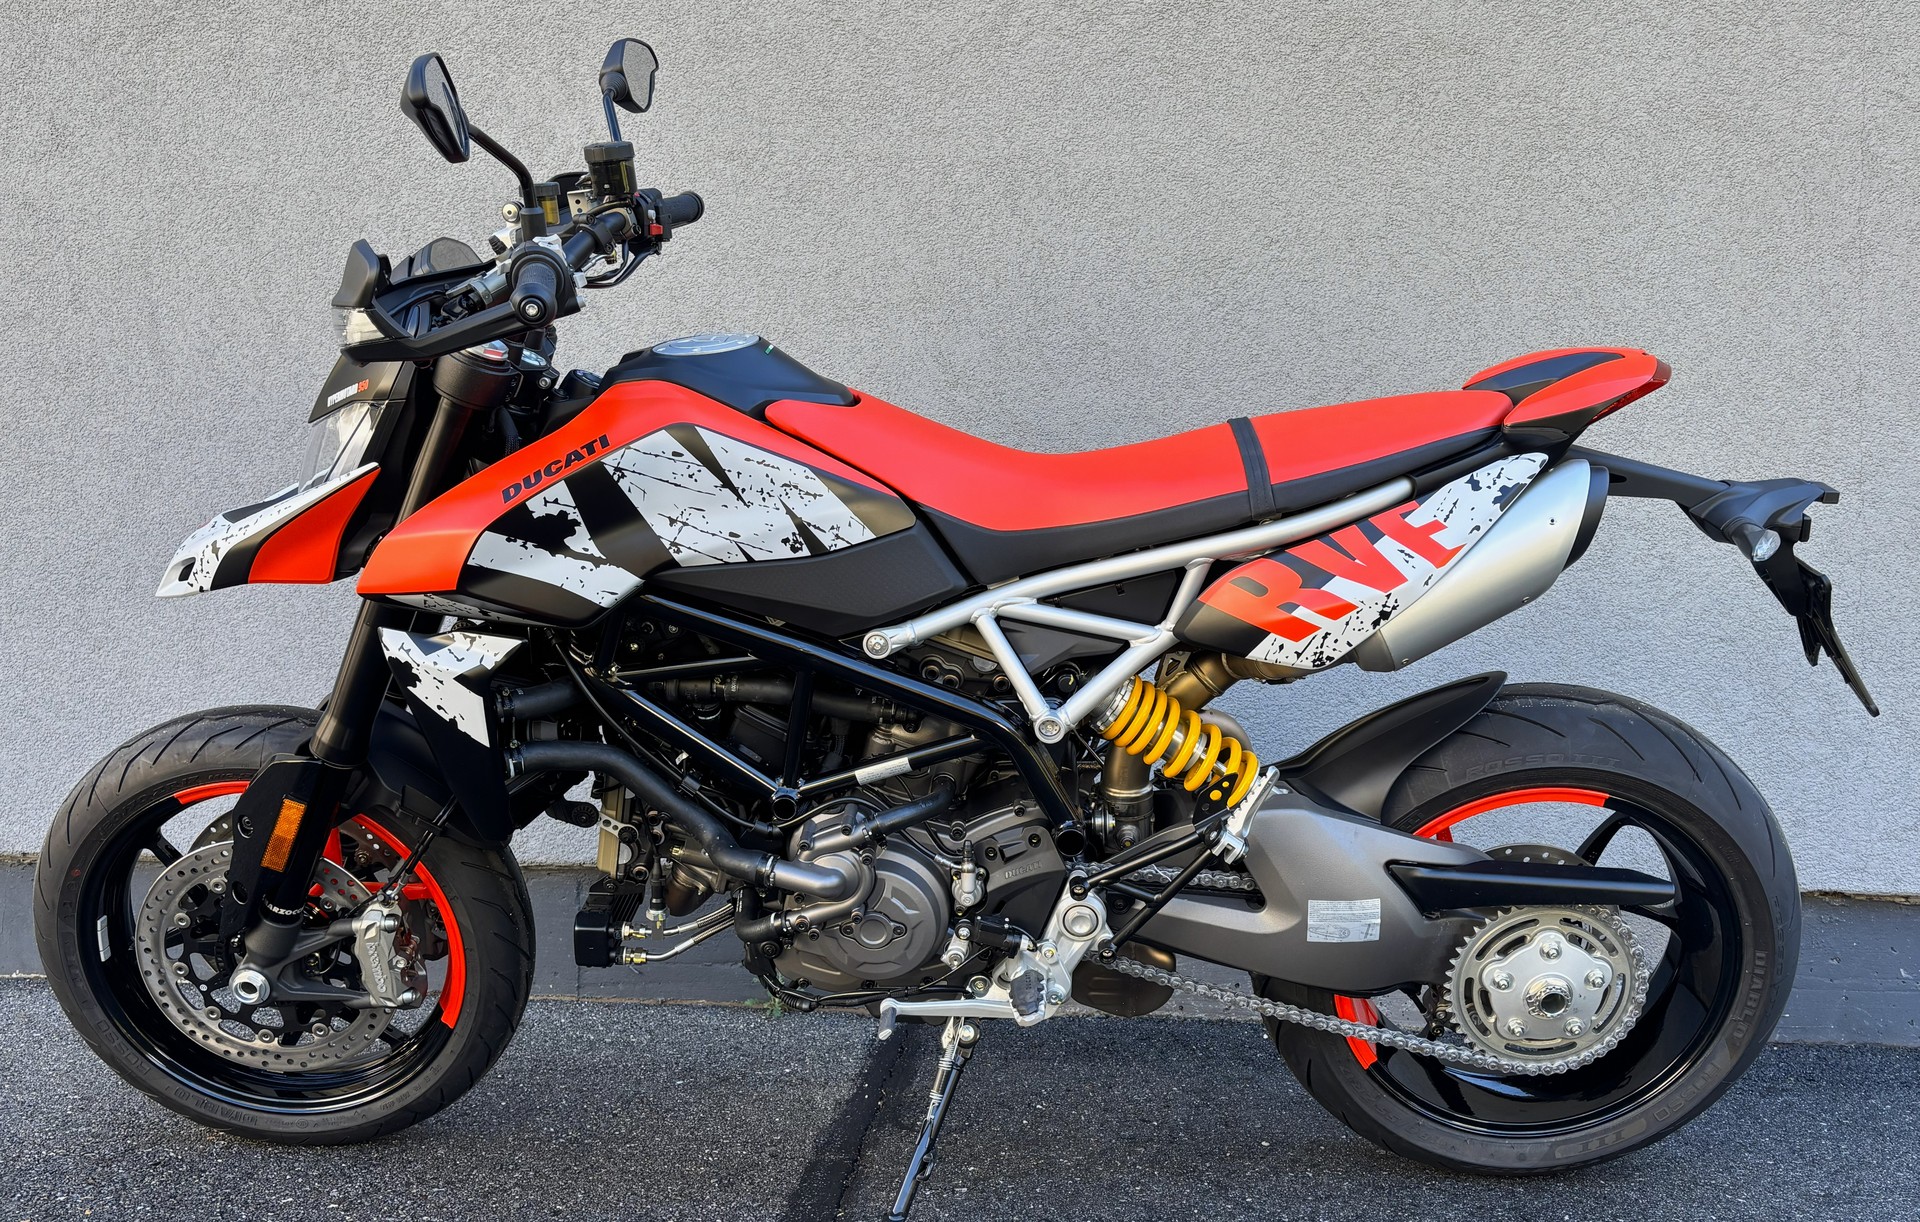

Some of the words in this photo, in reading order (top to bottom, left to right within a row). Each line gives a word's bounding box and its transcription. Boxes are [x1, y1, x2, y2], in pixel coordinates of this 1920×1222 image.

[501, 433, 611, 504] DUCATI
[1197, 499, 1468, 643] RVE
[1465, 753, 1565, 781] ROSSO
[1004, 860, 1043, 880] DUCATI
[365, 941, 387, 993] brembo
[1731, 950, 1769, 1041] DIABLO
[96, 1018, 151, 1075] ROSSO
[1653, 1061, 1728, 1123] ROSSO
